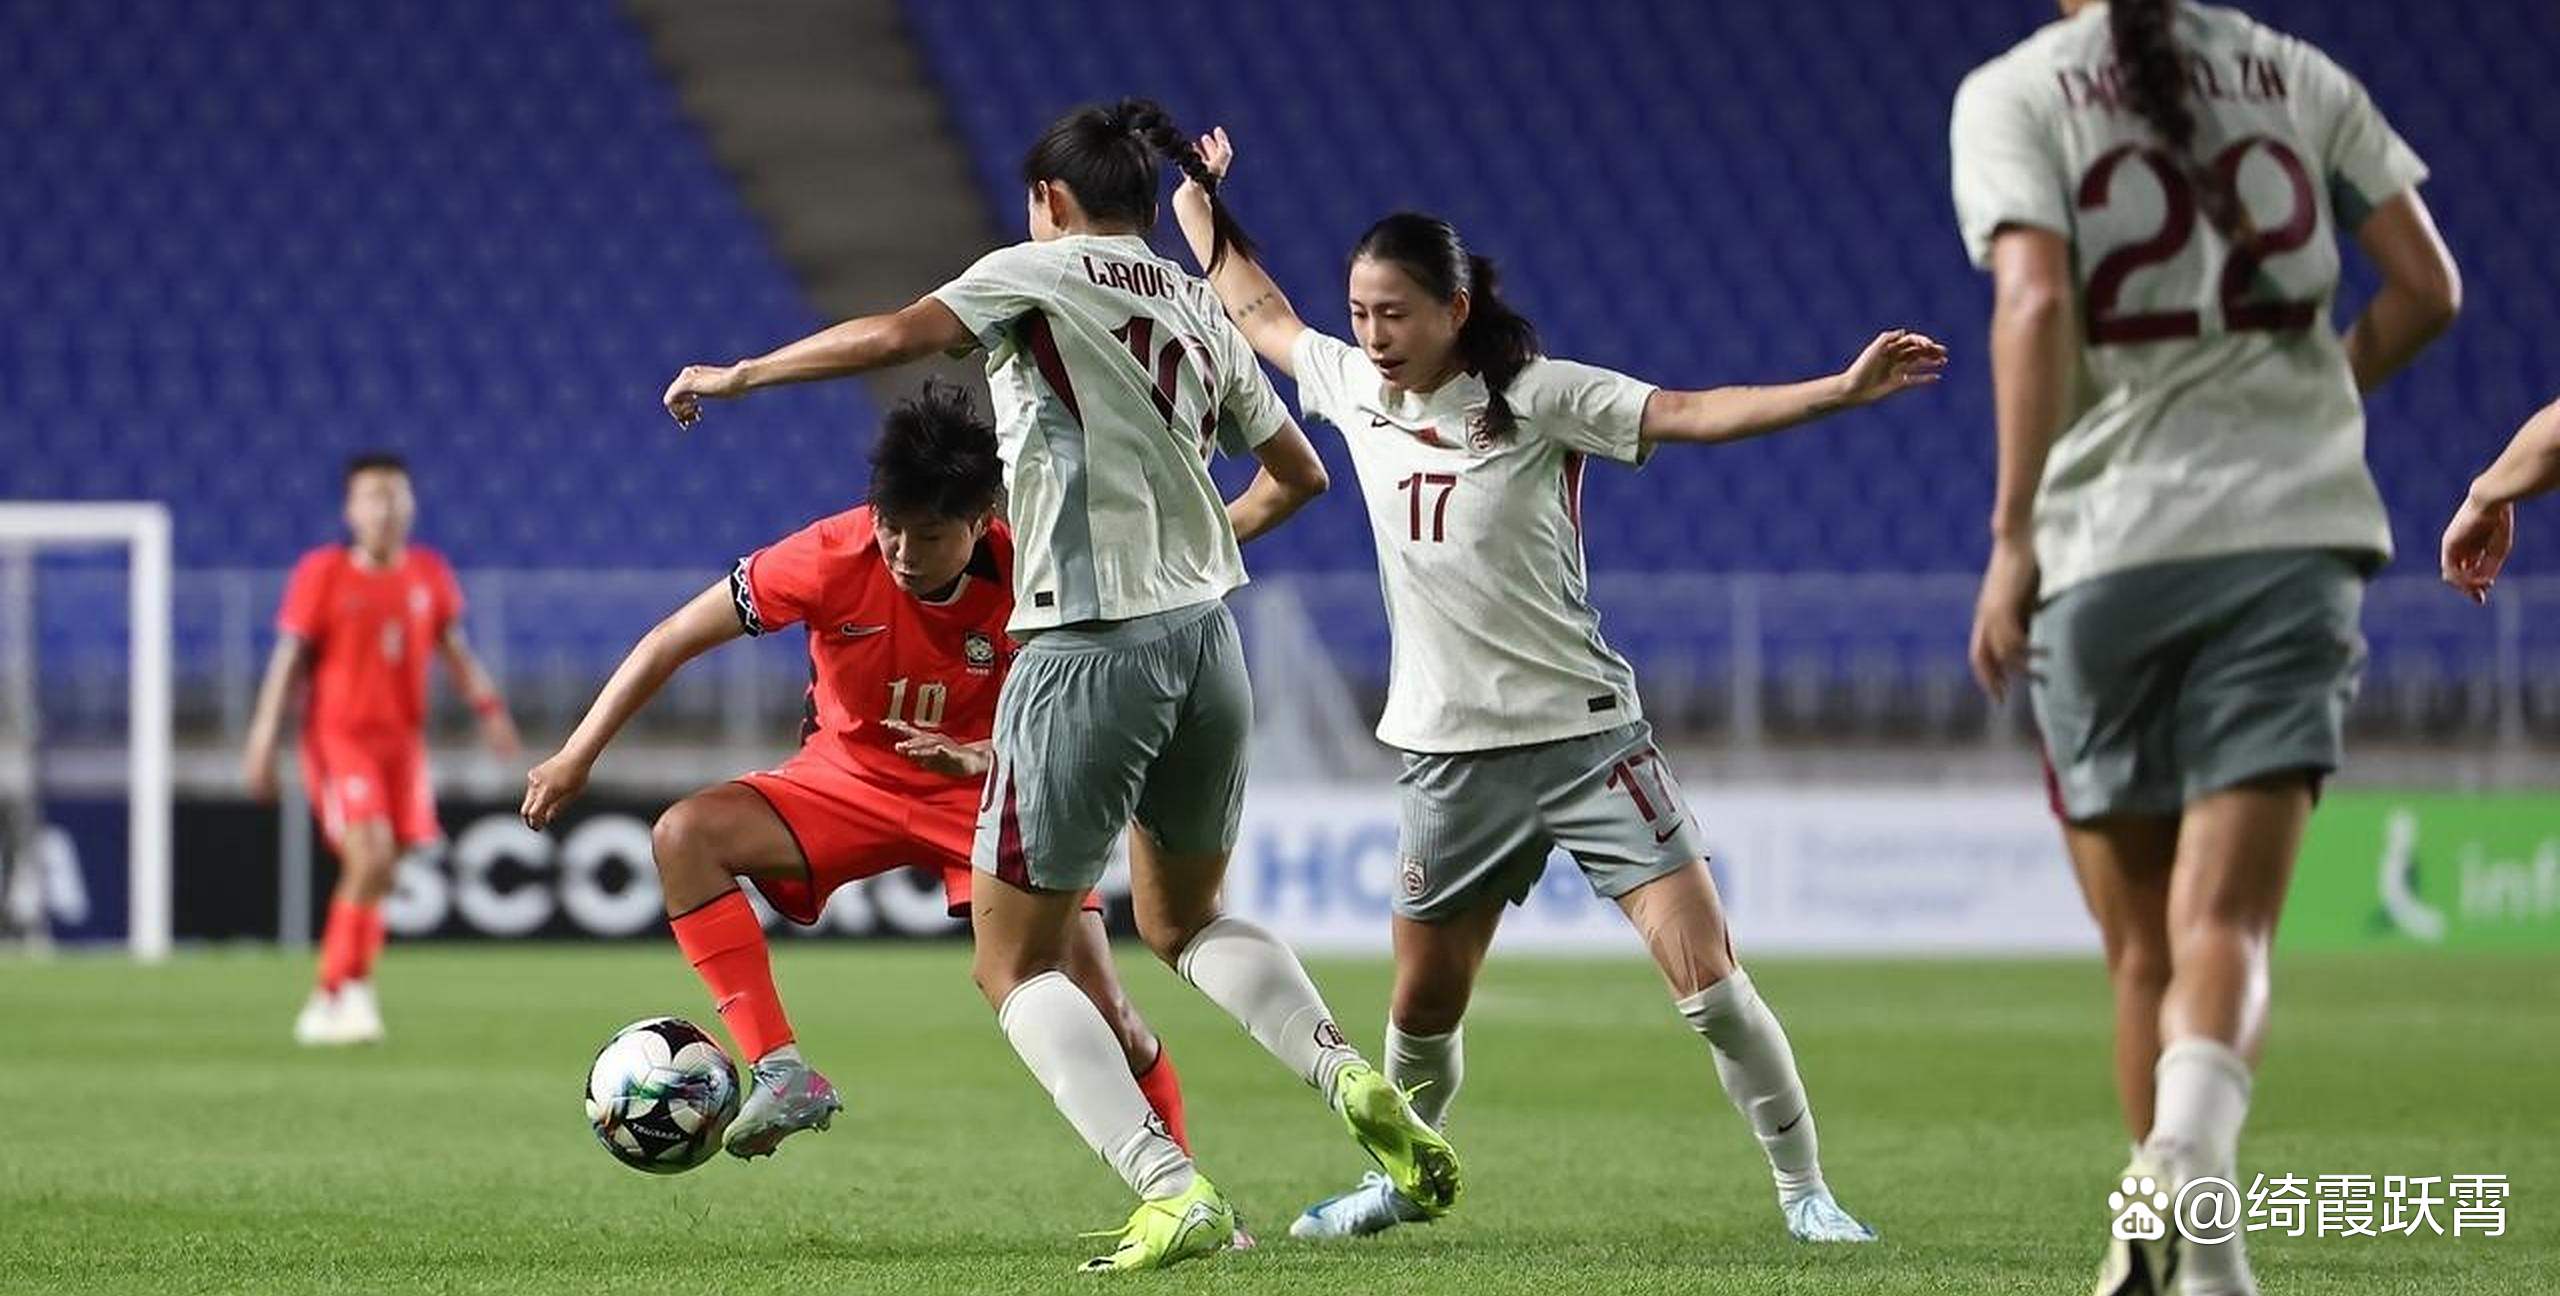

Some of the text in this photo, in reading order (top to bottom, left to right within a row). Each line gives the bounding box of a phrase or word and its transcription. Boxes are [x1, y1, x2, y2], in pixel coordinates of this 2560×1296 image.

[2078, 135, 2316, 346] 22
[1082, 256, 1174, 300] WANG
[1397, 472, 1457, 543] 17
[883, 676, 947, 728] 10
[1606, 748, 1676, 822] 17
